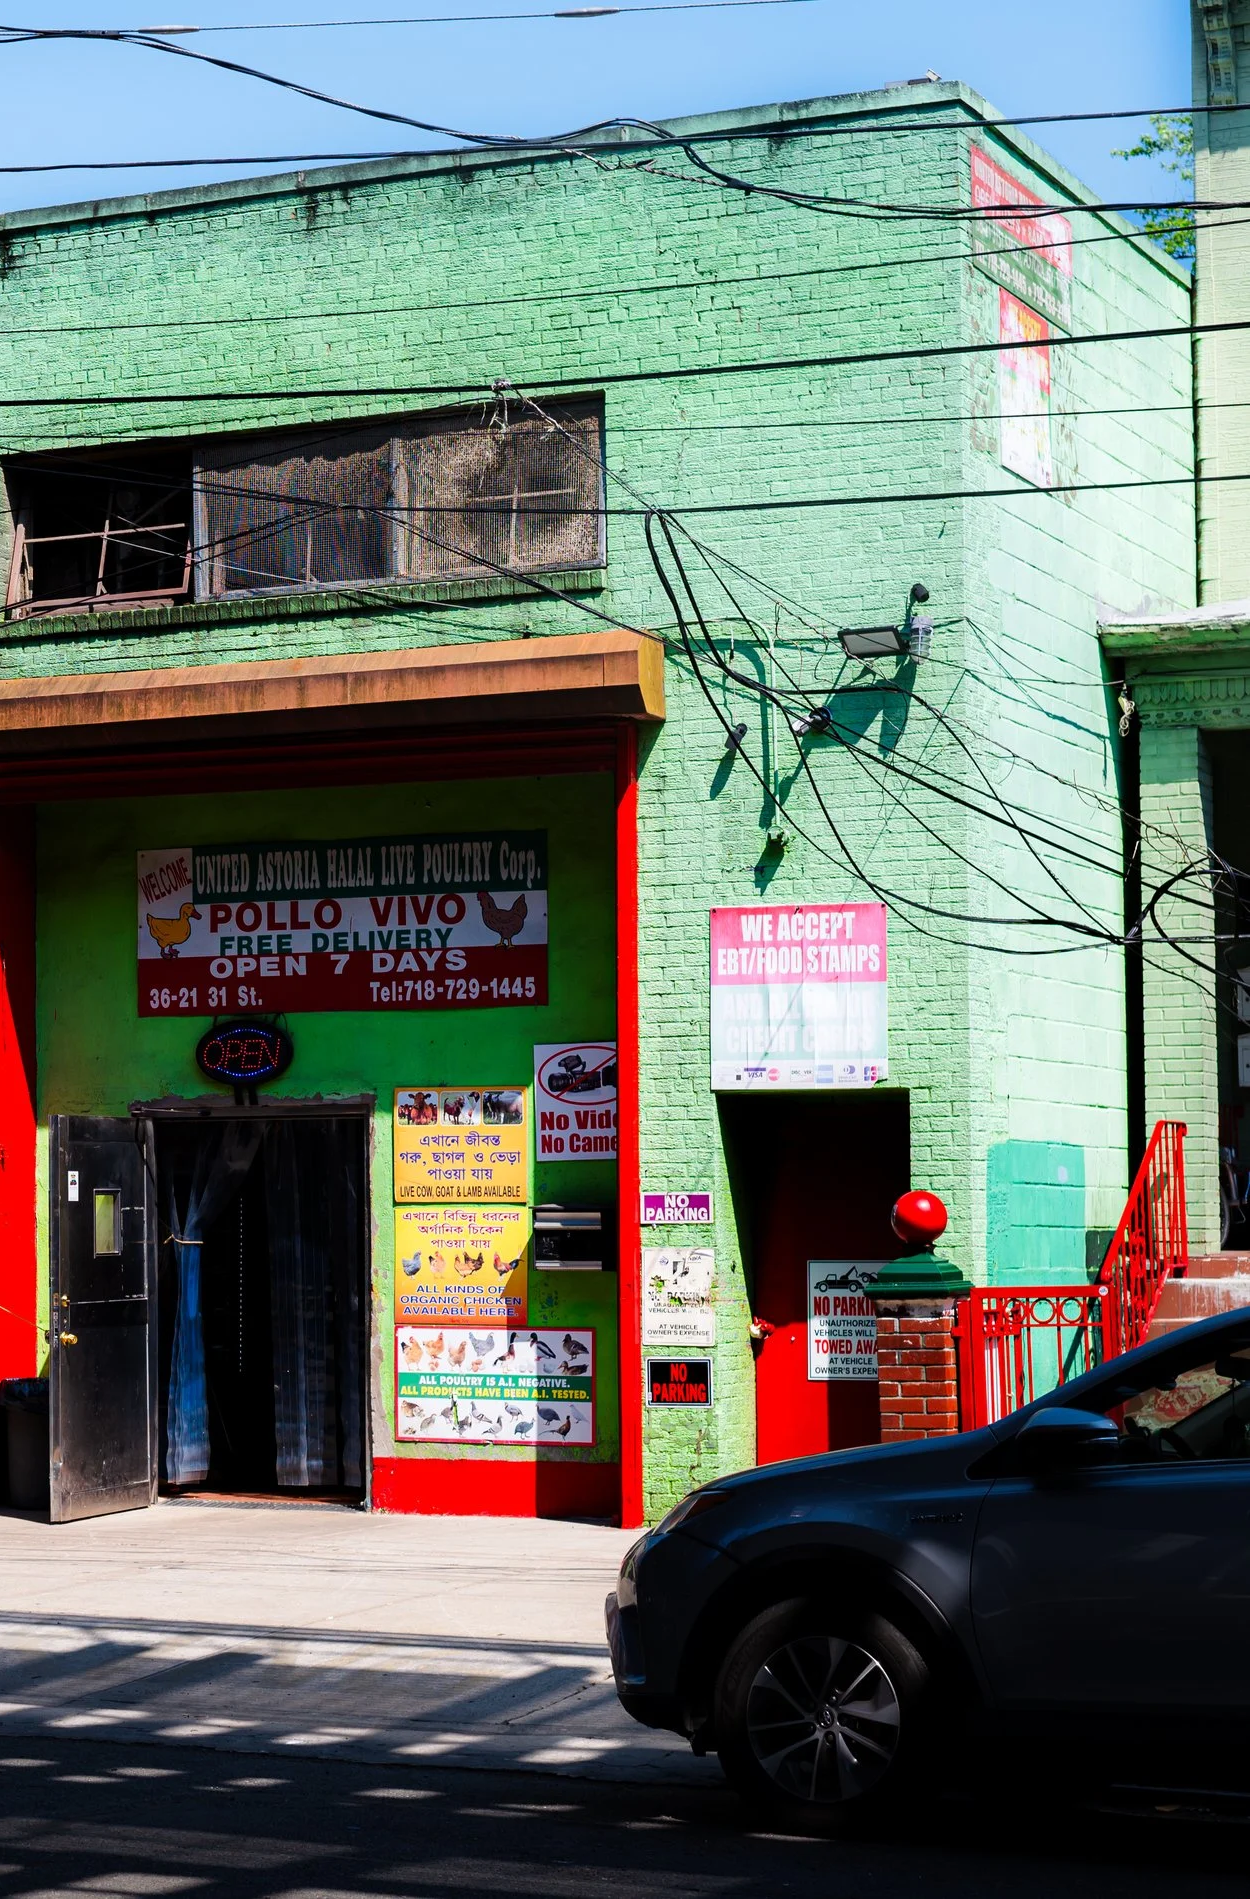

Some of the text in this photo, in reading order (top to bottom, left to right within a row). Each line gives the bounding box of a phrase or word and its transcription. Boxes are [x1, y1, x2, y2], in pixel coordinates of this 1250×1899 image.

[195, 840, 540, 894] UNITED ASTORIA HALAL LIVE POULTRY Corp.
[139, 857, 193, 904] WELCOME
[209, 893, 466, 933] POLLO VIVO
[741, 911, 855, 942] WE ACCEPT
[219, 927, 454, 956] FREE DELIVERY
[210, 949, 467, 979] OPEN 7 DAYS
[717, 944, 881, 976] EBT/FOOD STAMPS
[370, 976, 536, 1003] Tel:718-729-1445
[150, 986, 263, 1009] 36-21 31 St.
[203, 1038, 281, 1069] OPEN
[540, 1111, 569, 1131] No
[419, 1132, 501, 1147] এখানে জীবন্ত
[541, 1132, 617, 1154] No Came
[432, 1152, 465, 1166] ছাগল
[473, 1152, 484, 1166] ও
[470, 1168, 493, 1181] যায়
[400, 1186, 415, 1198] LIVE
[435, 1186, 455, 1198] GOAT
[456, 1186, 462, 1198] &
[463, 1186, 483, 1198] LAMB
[483, 1186, 521, 1198] AVAILABLE
[664, 1195, 690, 1208] NO
[402, 1210, 439, 1222] এখানে
[482, 1210, 520, 1222] ধরনের
[645, 1207, 708, 1221] PARKING
[468, 1224, 504, 1235] চিকেন
[470, 1239, 491, 1249] যায়
[416, 1285, 505, 1294] ALL KINDS OF
[400, 1295, 521, 1305] ORGANIC CHICKEN
[813, 1296, 877, 1316] NO PARKIN
[403, 1306, 475, 1316] AVAILABLE
[814, 1329, 874, 1337] VEHICLES WILL
[815, 1339, 878, 1355] TOWED AWA
[829, 1357, 873, 1365] AT VEHICLE
[670, 1363, 687, 1381] NO
[815, 1367, 877, 1375] OWNER'S EXPEN
[419, 1375, 570, 1388] ALL POULTRY IS A.I. NEGATIVE.
[400, 1386, 418, 1395] ALL
[475, 1388, 501, 1397] HAVE
[503, 1389, 529, 1398] BEEN
[531, 1389, 548, 1398] A.I.
[552, 1390, 589, 1400] TESTED.
[652, 1383, 706, 1402] PARKING
